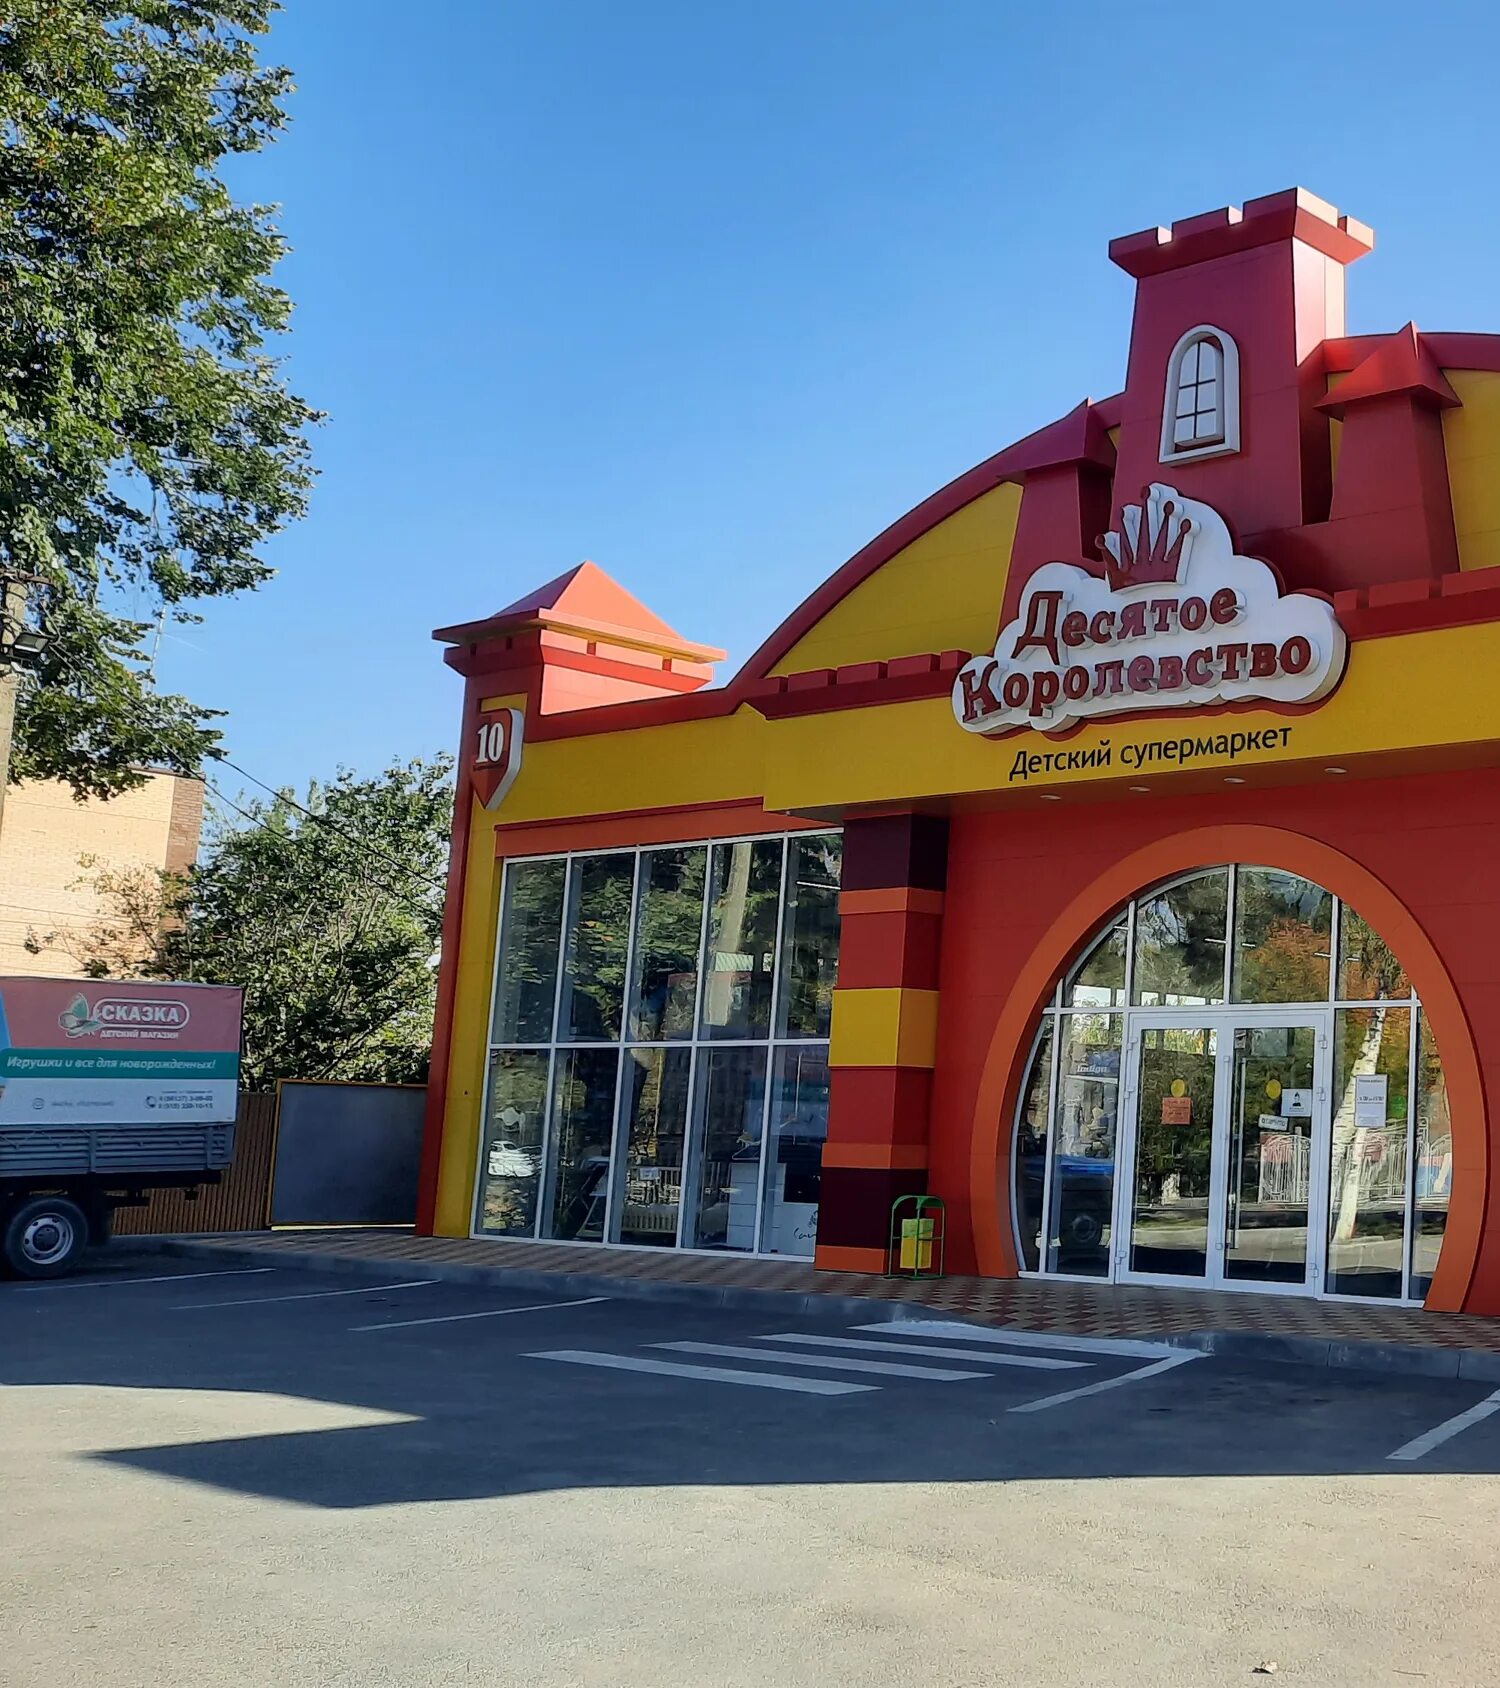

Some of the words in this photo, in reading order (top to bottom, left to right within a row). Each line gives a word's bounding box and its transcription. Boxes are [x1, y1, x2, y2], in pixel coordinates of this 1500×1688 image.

[1011, 587, 1239, 666] Десятое
[958, 635, 1313, 724] Королевство
[475, 722, 504, 763] 10
[1009, 740, 1112, 782] Детский
[1120, 726, 1292, 768] супермаркет
[101, 1004, 180, 1022] СКАЗКА
[7, 1056, 63, 1069] Игрушки
[64, 1059, 73, 1068] и
[74, 1059, 94, 1068] все
[96, 1057, 118, 1069] для
[119, 1058, 216, 1070] новорожденных!
